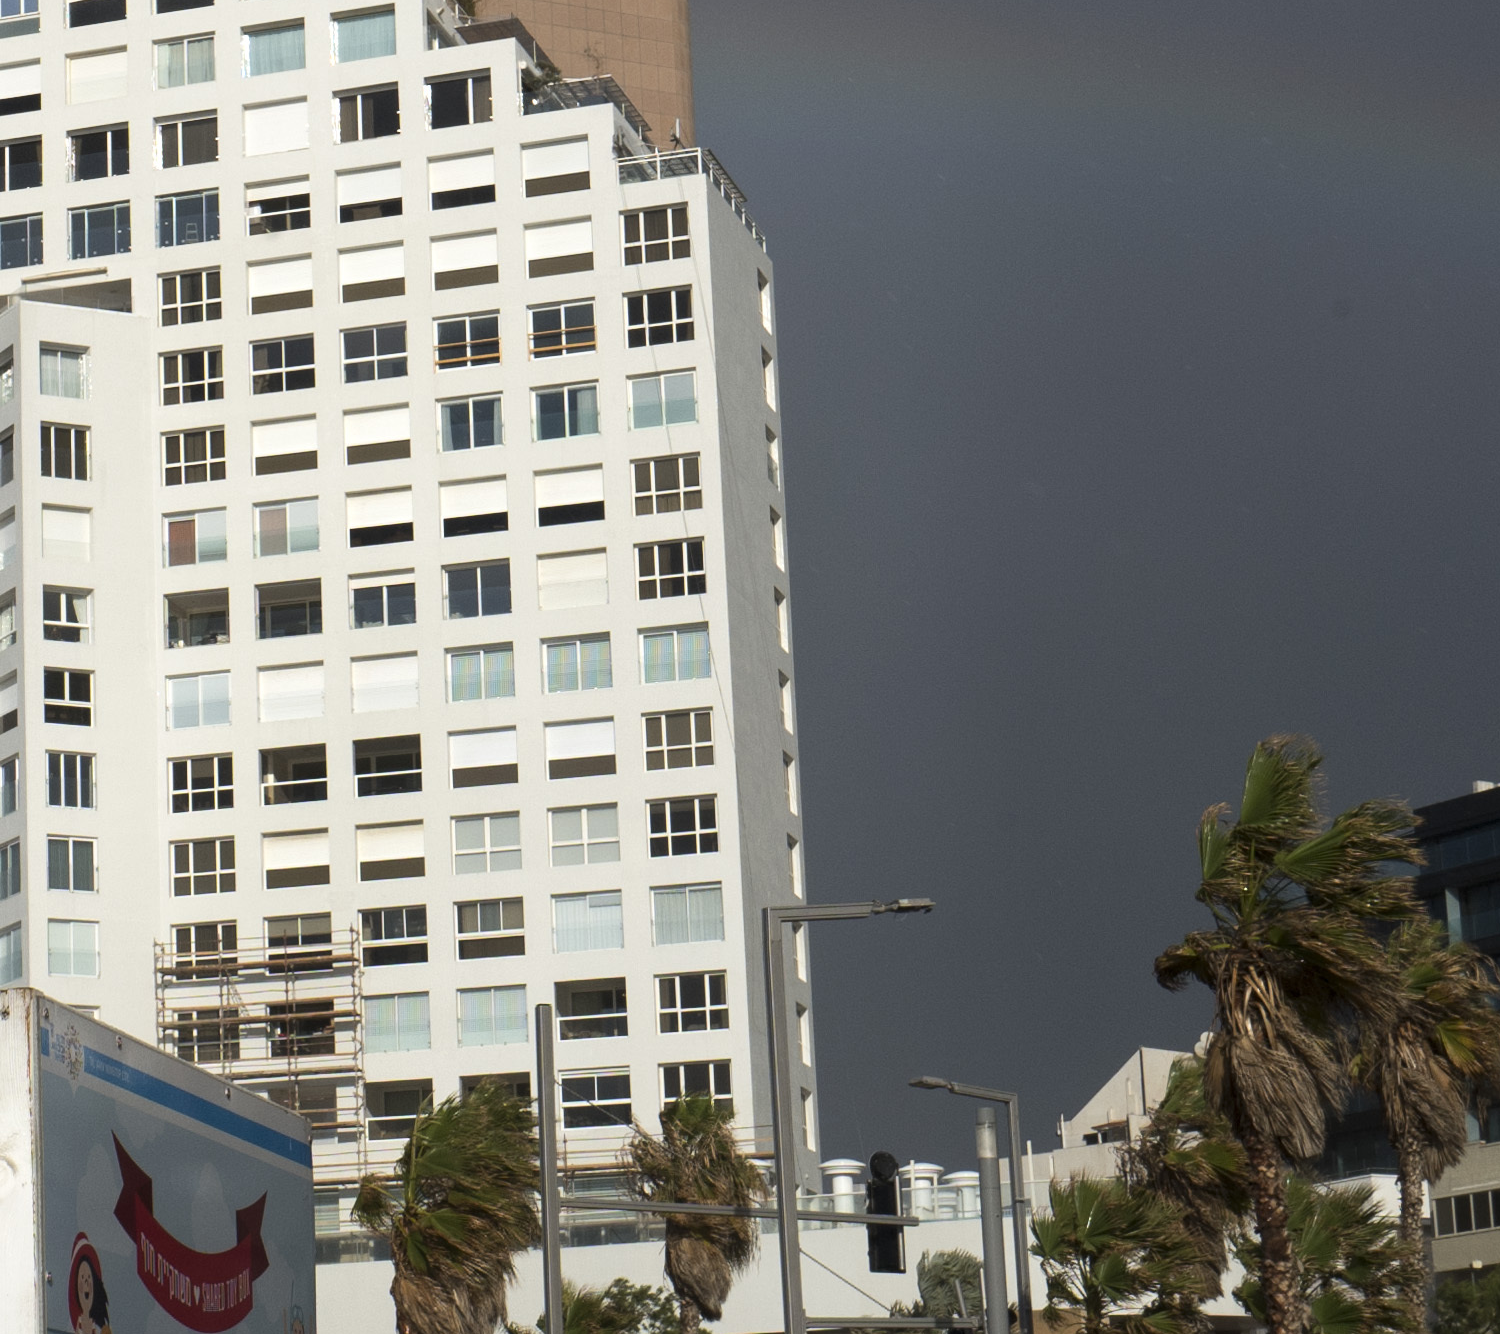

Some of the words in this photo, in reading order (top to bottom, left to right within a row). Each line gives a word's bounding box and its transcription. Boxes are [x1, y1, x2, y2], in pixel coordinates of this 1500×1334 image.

[202, 1282, 225, 1312] SHARED
[226, 1278, 237, 1309] TOY
[238, 1267, 250, 1303] BOX
